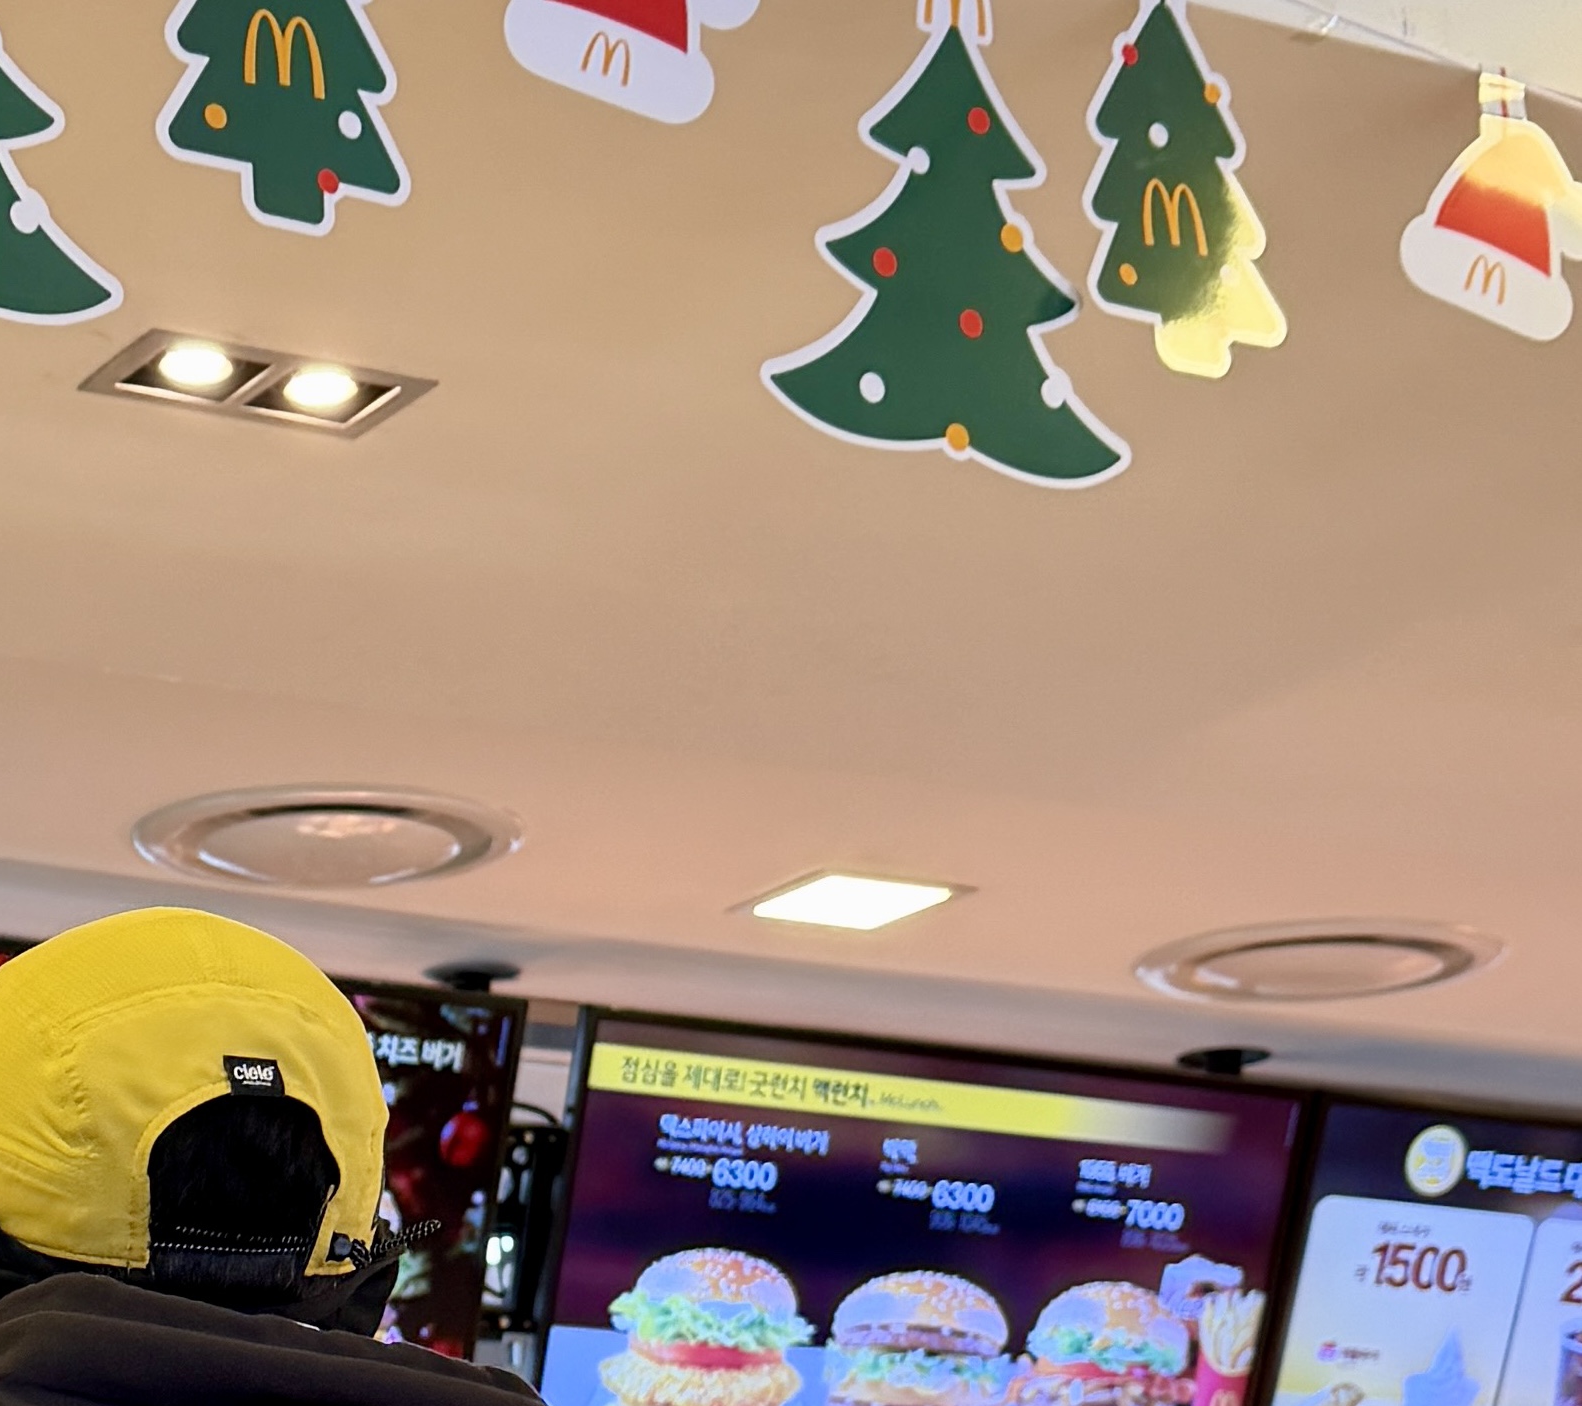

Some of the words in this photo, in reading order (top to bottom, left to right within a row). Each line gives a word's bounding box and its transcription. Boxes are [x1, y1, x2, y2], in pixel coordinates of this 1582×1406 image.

[376, 1033, 419, 1067] 치즈
[421, 1039, 465, 1073] 버거
[622, 1056, 678, 1088] 점심을
[712, 1157, 779, 1192] 6300
[932, 1179, 995, 1213] 6300
[1124, 1199, 1185, 1232] 7000
[1372, 1240, 1466, 1293] 1500
